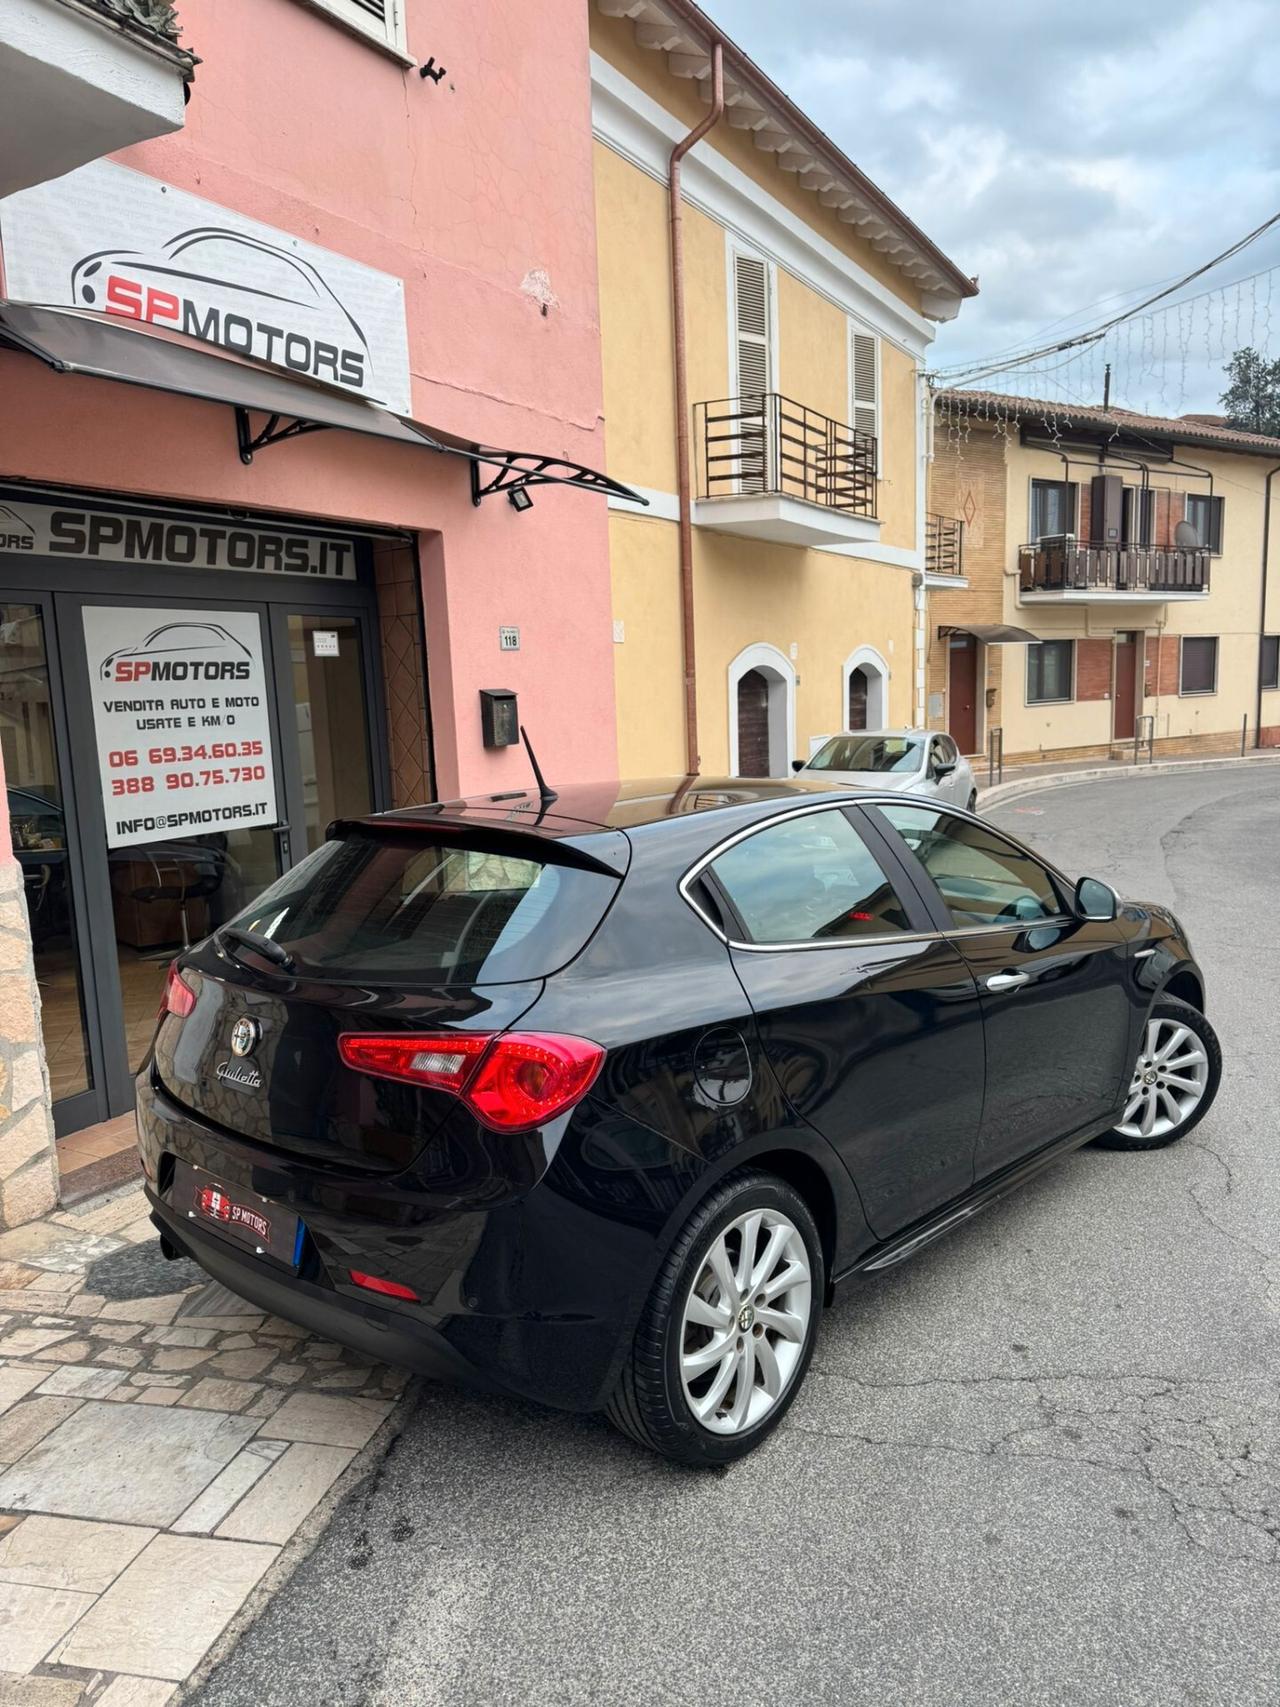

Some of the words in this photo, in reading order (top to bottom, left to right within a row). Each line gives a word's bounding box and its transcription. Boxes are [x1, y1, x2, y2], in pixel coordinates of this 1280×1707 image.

[106, 275, 364, 387] SPMOTORS
[49, 511, 351, 576] SPMOTORS.IT
[504, 635, 517, 646] 118
[115, 661, 250, 682] SPMOTORS
[103, 700, 164, 713] VENDITA
[171, 698, 206, 710] AUTO
[212, 698, 220, 708] E
[225, 696, 260, 708] MOTO
[136, 717, 182, 730] USATE
[188, 716, 196, 727] E
[109, 750, 139, 768] 06
[149, 740, 263, 764] 69.34.60.35
[111, 776, 155, 796] 388
[166, 765, 265, 790] 90.75.730
[116, 802, 268, 835] INFO@SPMOTORS.IT
[216, 1061, 261, 1088] Giulietta
[232, 1206, 241, 1220] SP
[241, 1209, 267, 1236] MOTORS
